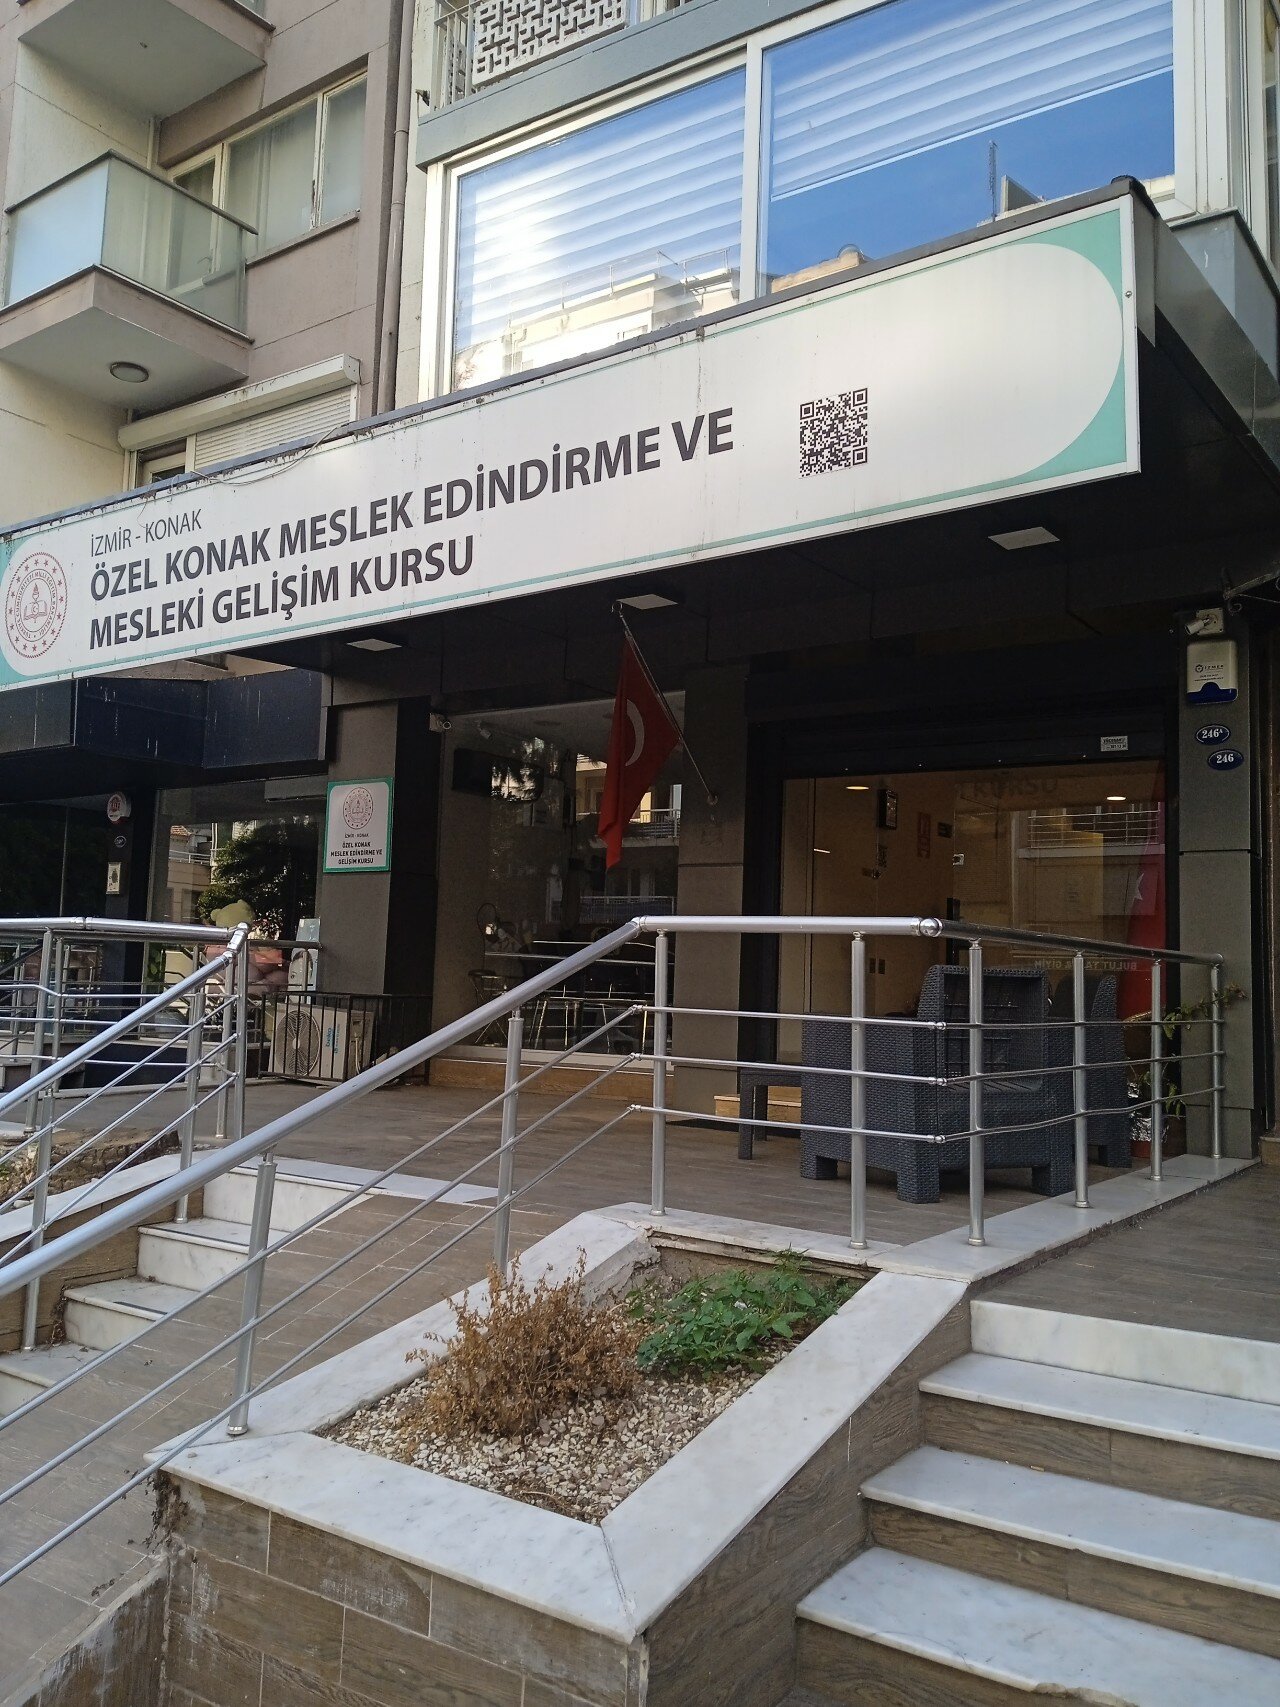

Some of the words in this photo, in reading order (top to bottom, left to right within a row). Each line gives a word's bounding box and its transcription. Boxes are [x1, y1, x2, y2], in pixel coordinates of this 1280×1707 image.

[90, 561, 158, 601] ÖZEL
[165, 527, 271, 585] KONAK
[279, 491, 414, 559] MESLEK
[423, 426, 661, 525] EDİNDİRME
[671, 407, 734, 462] VE
[91, 527, 132, 557] İZMİR
[145, 508, 202, 543] KONAK
[89, 587, 204, 650] MESLEKİ
[212, 563, 339, 624] GELİŞİM
[350, 534, 474, 598] KURSU
[1216, 753, 1234, 764] 246
